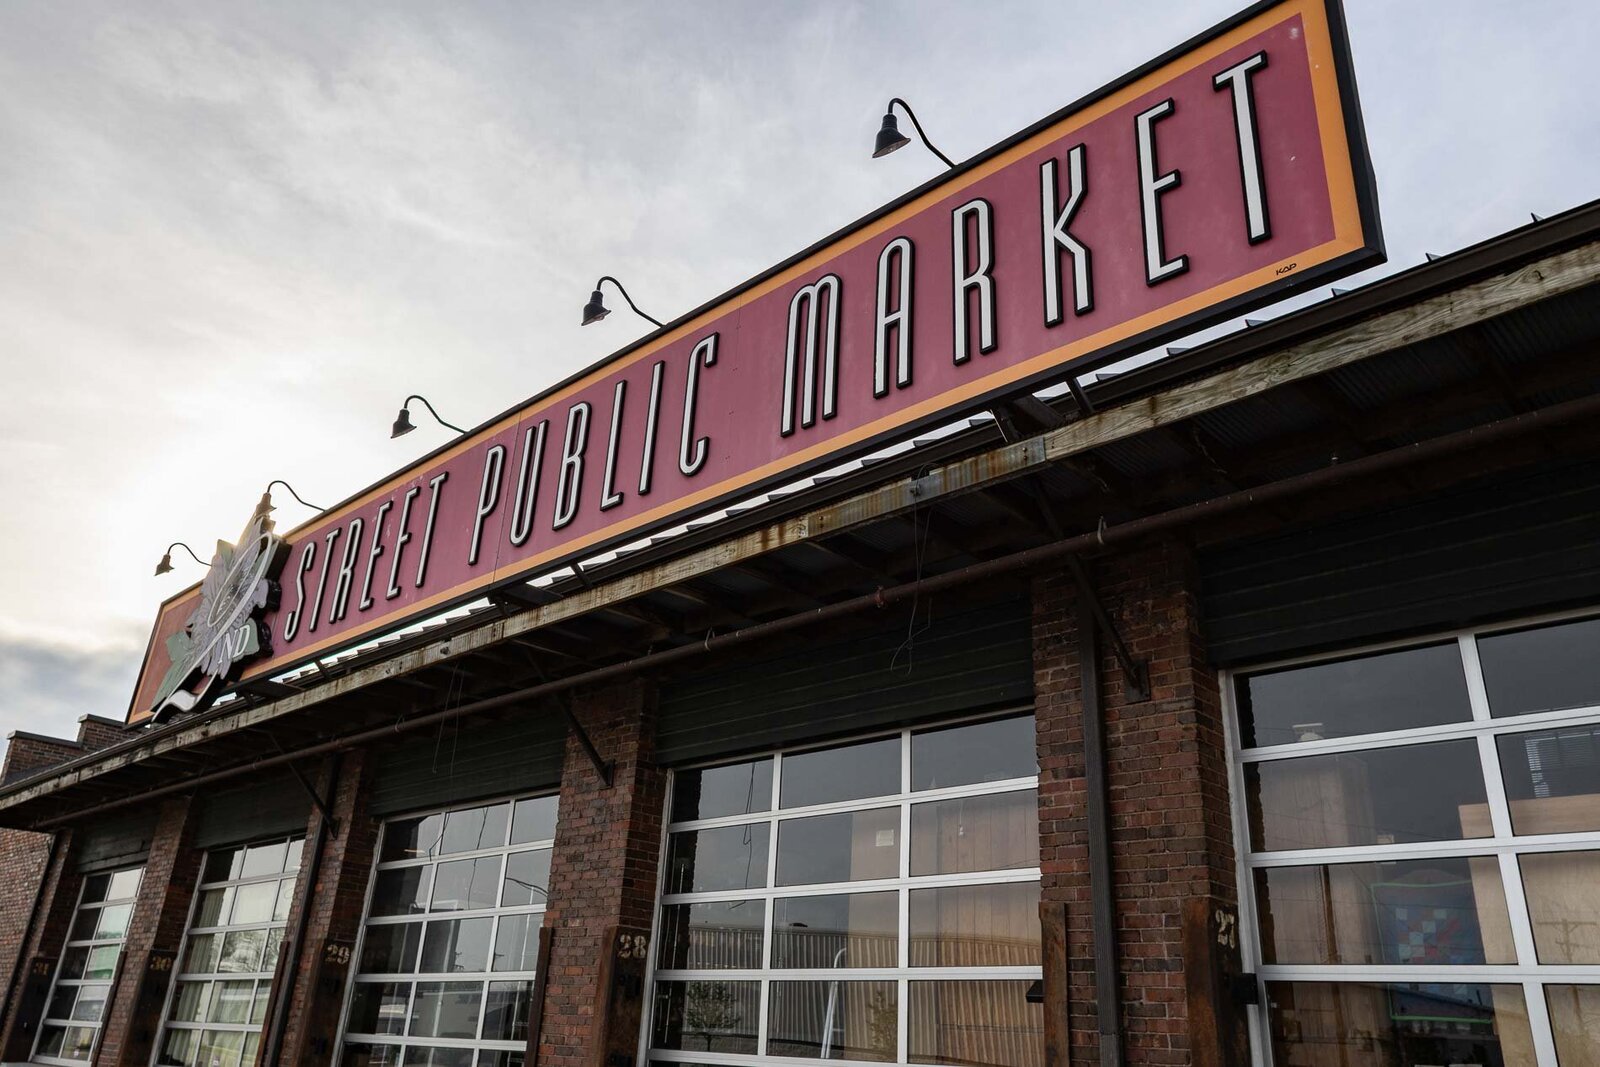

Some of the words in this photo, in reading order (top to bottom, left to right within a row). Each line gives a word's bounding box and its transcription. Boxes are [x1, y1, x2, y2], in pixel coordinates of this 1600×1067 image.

[1275, 262, 1297, 276] KAP
[283, 471, 448, 641] STREET
[468, 332, 719, 566] PUBLIC
[780, 50, 1271, 437] MARKET
[1215, 909, 1235, 949] 27
[325, 944, 350, 965] 29
[617, 934, 647, 959] 28
